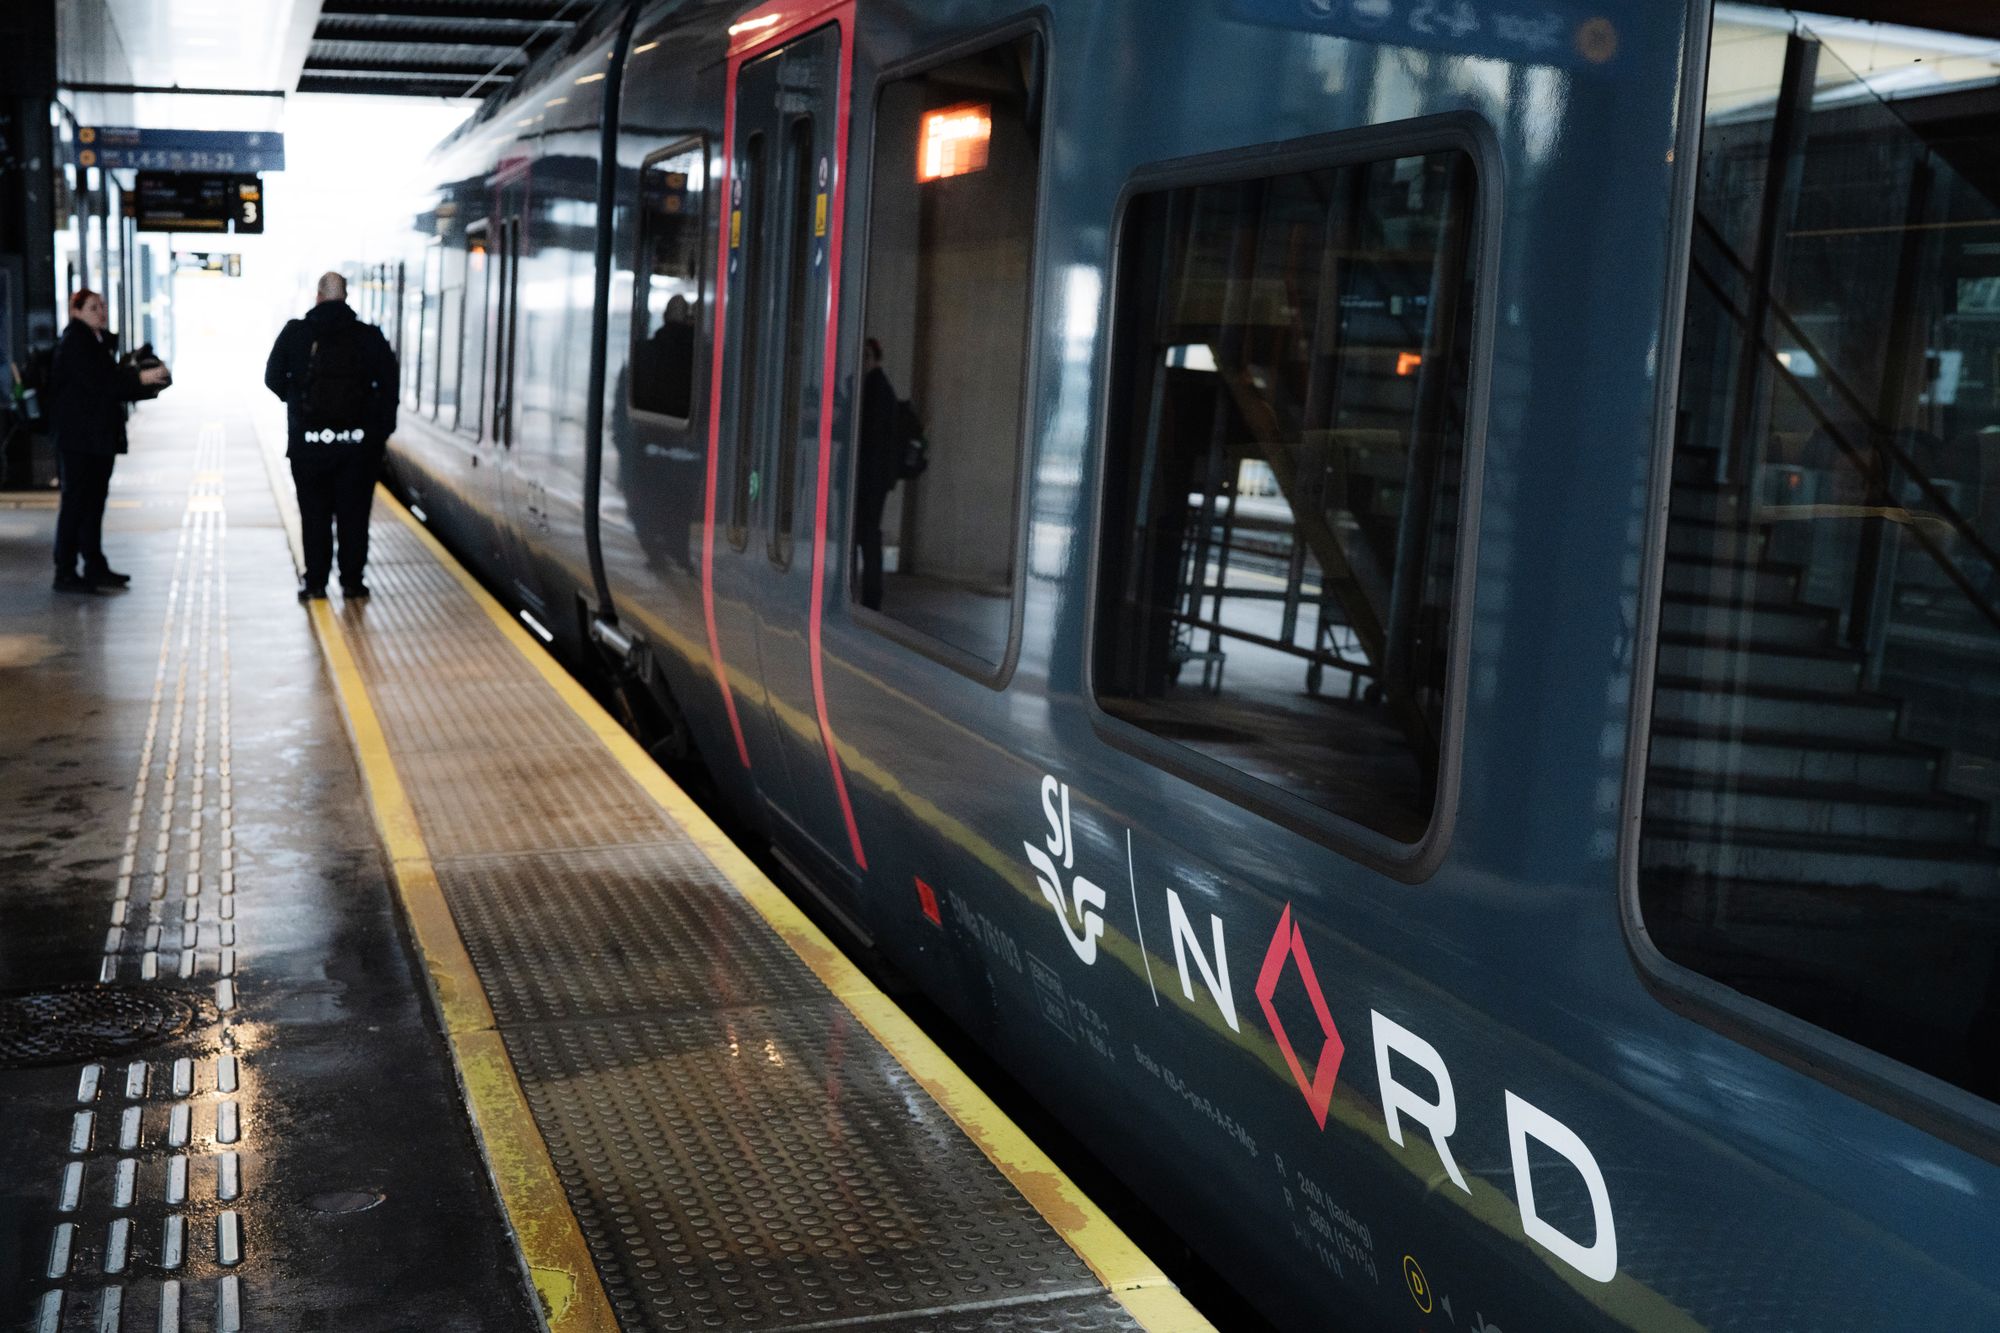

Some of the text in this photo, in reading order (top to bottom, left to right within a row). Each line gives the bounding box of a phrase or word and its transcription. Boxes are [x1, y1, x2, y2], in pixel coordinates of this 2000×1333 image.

[242, 201, 257, 224] 3
[1041, 774, 1073, 869] SJ
[1166, 887, 1618, 1283] NORD
[1273, 1152, 1373, 1251] R 240t (tauing)
[1282, 1186, 1295, 1211] R
[1334, 1227, 1378, 1285] (151%)
[1411, 1270, 1424, 1295] D
